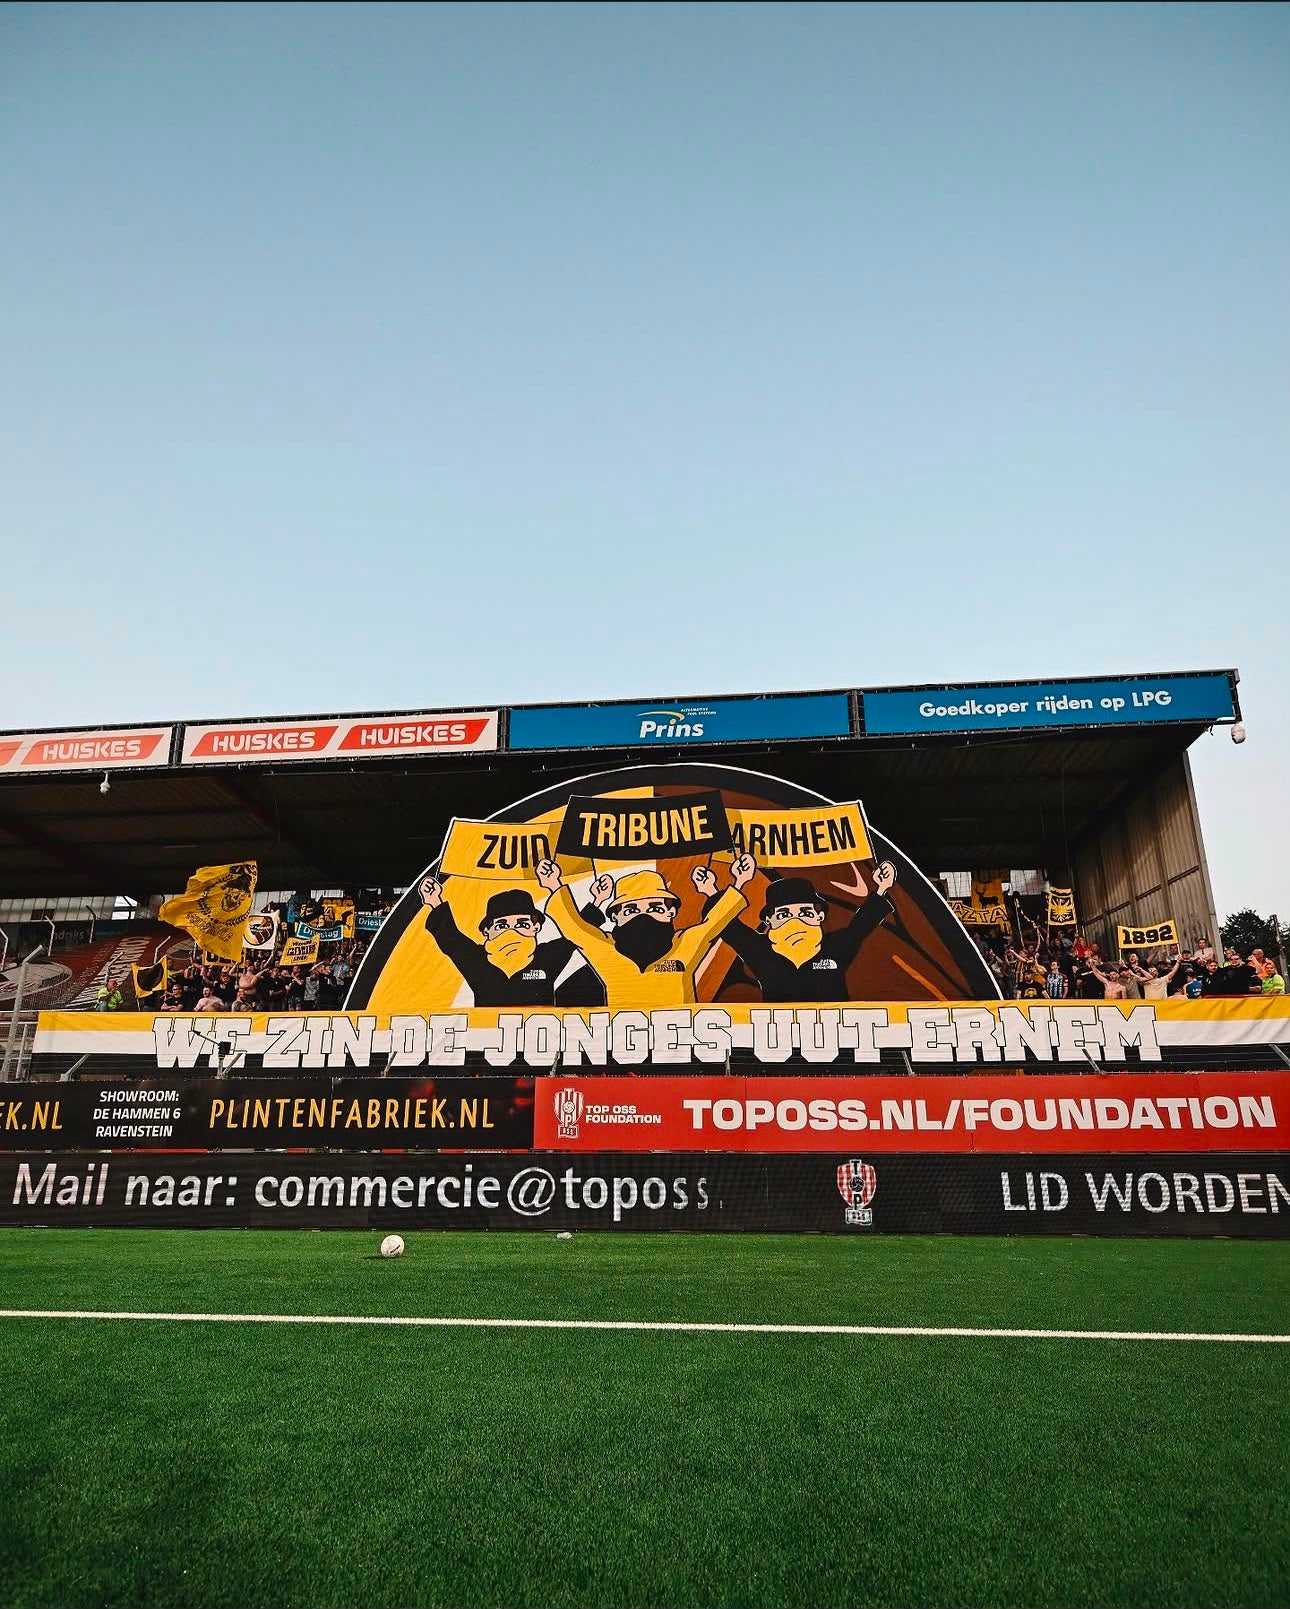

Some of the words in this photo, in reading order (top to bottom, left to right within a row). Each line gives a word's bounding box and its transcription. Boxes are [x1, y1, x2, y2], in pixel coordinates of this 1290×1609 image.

[919, 700, 1029, 717] Goedkoper
[1036, 695, 1093, 714] rijden
[1100, 696, 1125, 711] op
[1131, 690, 1172, 707] LPG
[361, 724, 466, 746] HUISKES
[639, 718, 704, 738] Prins
[42, 740, 141, 761] HUISKES
[213, 731, 316, 752] HUISKES
[579, 805, 713, 847] TRIBUNE
[728, 816, 856, 856] ARNHEM
[477, 834, 552, 869] ZUID
[1122, 924, 1173, 945] 1892
[152, 1017, 252, 1068] WE
[262, 1016, 376, 1068] ZIN
[390, 1014, 468, 1066] DE
[484, 1008, 731, 1066] JONGES
[750, 1008, 888, 1062] UUT
[906, 1005, 1161, 1062] ERNEM
[100, 1090, 179, 1102] SHOWROOM:
[93, 1108, 110, 1120] DE
[112, 1108, 171, 1120] HAMMEN
[173, 1107, 181, 1119] 6
[209, 1098, 495, 1130] PLINTENFABRIEK.NL
[585, 1105, 609, 1114] TOP
[612, 1105, 637, 1114] OSS
[585, 1115, 661, 1124] FOUNDATION
[683, 1096, 1277, 1131] TOPOSS.NL/FOUNDATION
[96, 1125, 173, 1137] RAVENSTEIN
[12, 1163, 109, 1206] Mail
[125, 1173, 236, 1207] naar:
[1001, 1171, 1070, 1212] LID
[1085, 1172, 1290, 1214] WORDEN
